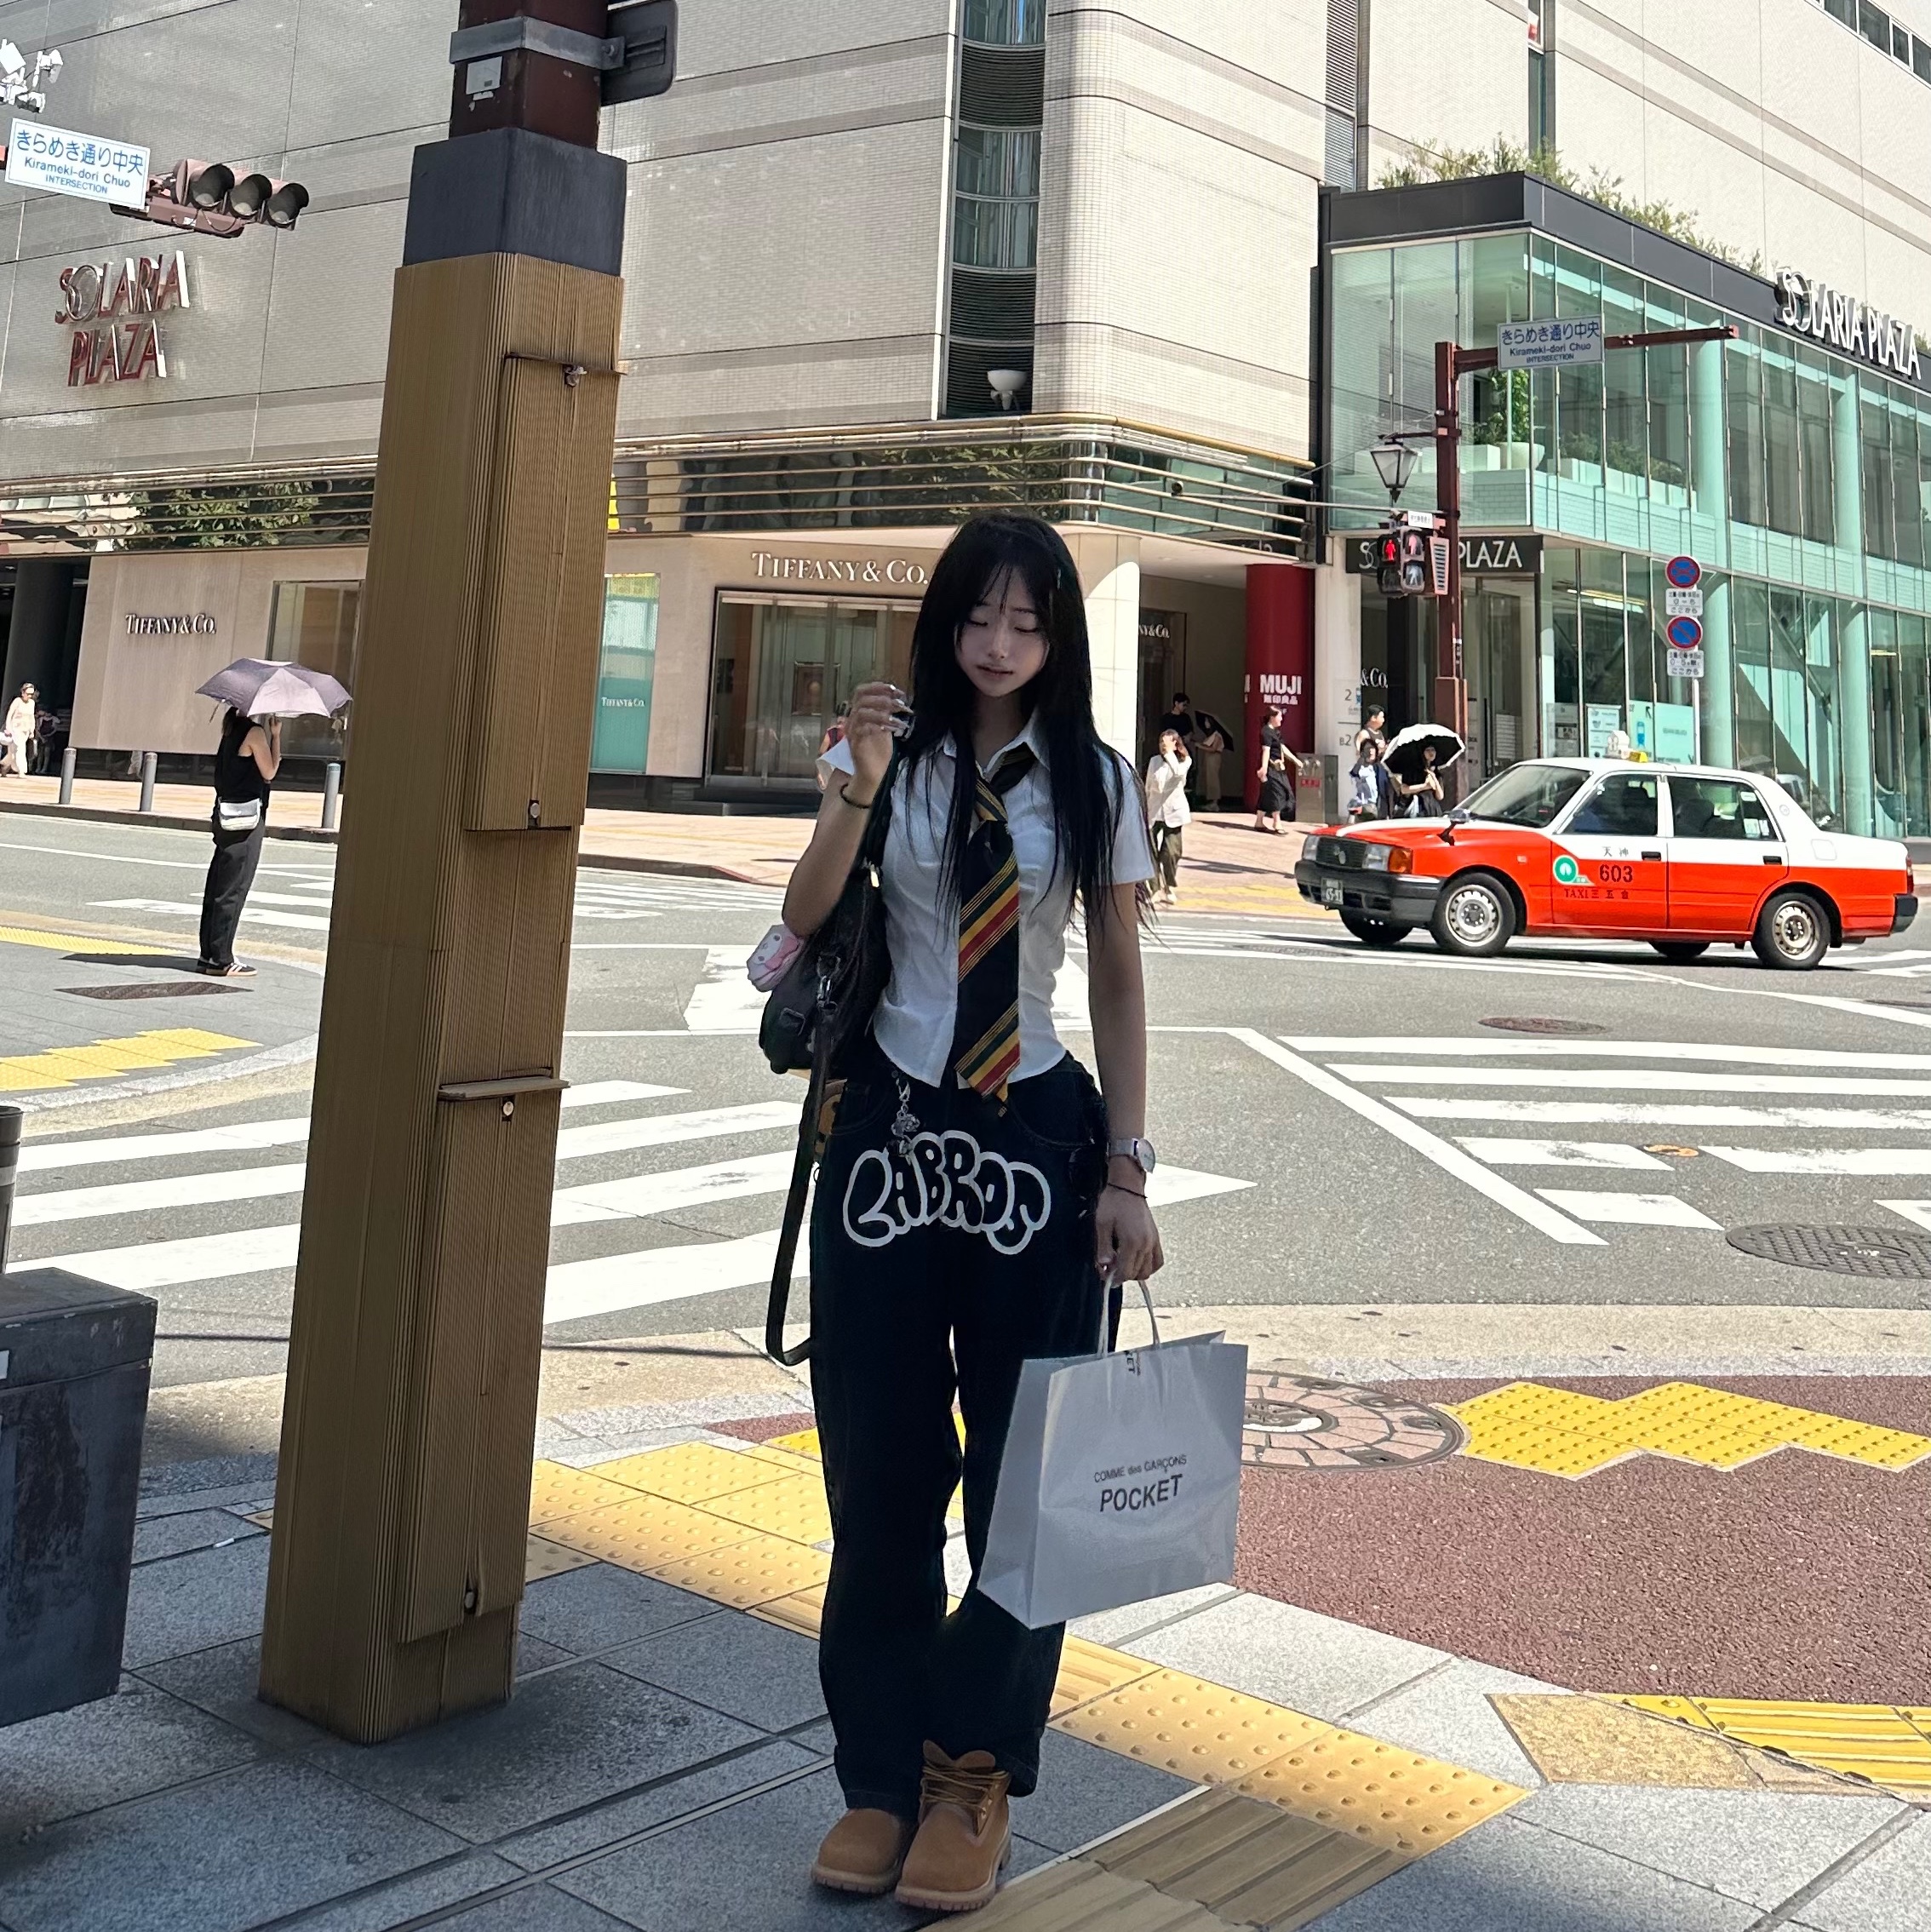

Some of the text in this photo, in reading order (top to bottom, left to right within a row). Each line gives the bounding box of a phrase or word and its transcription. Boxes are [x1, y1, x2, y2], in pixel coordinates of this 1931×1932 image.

[17, 129, 144, 175] きらめき通り中央
[25, 157, 130, 187] Kirameki-dori Chuo
[45, 175, 108, 194] INTERSECTION
[54, 250, 190, 324] SOLARIA
[1502, 321, 1600, 345] きらめき通り中央
[1777, 267, 1922, 381] SOLARIA PLAZA
[68, 318, 167, 387] PLAZA
[1510, 342, 1591, 357] Kirameki-dori Chuo
[1526, 353, 1574, 364] INTERSECTION
[1259, 674, 1302, 695] MUJI
[1344, 688, 1352, 701] 2
[1599, 863, 1633, 882] 603
[1094, 1453, 1187, 1483] COMME des GARÇONS
[1099, 1473, 1183, 1512] POCKET
